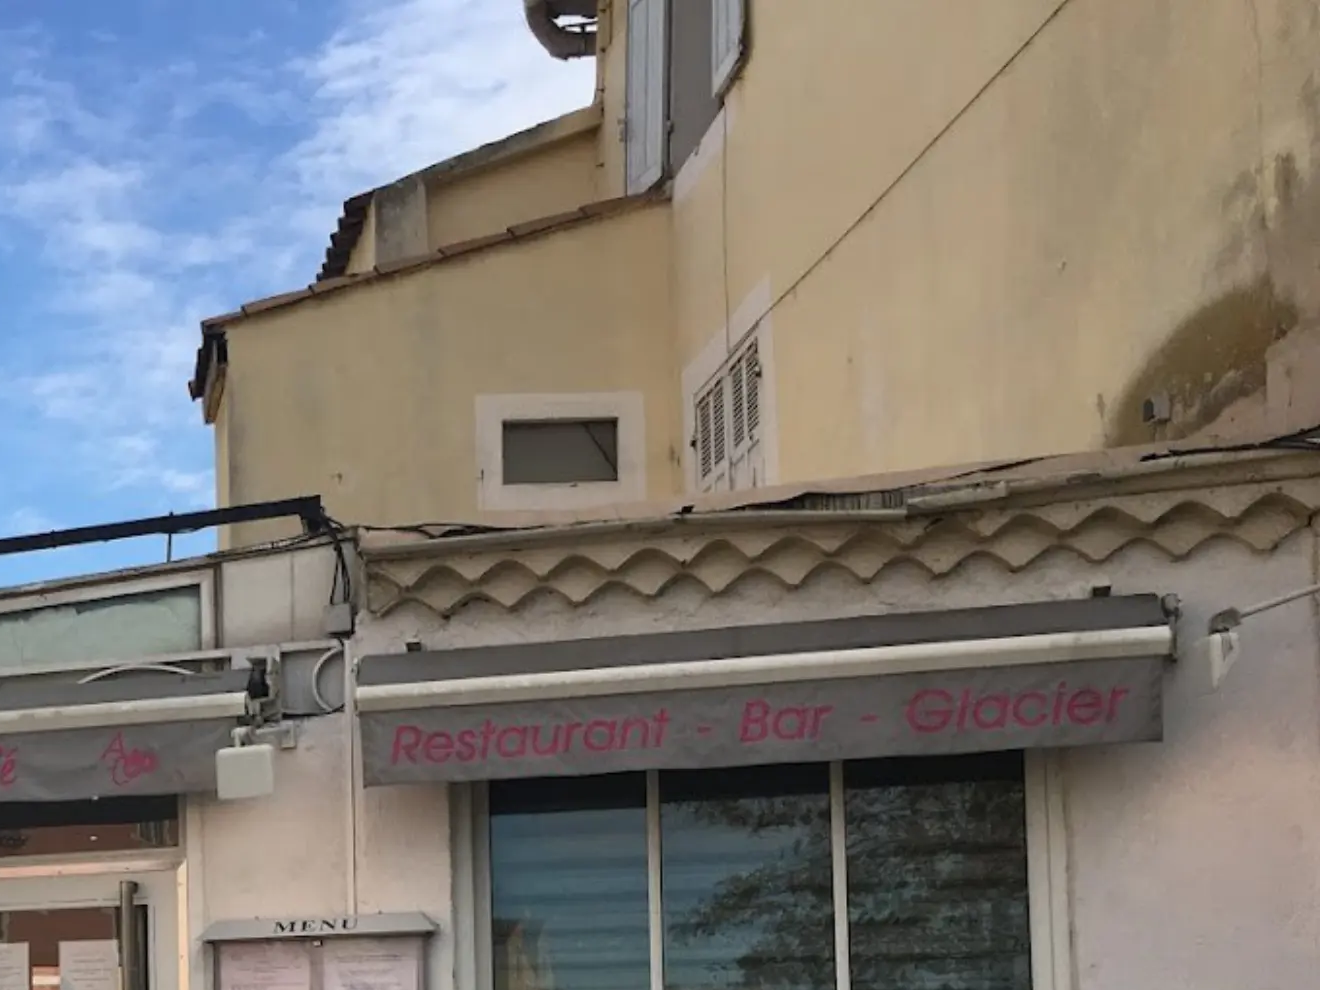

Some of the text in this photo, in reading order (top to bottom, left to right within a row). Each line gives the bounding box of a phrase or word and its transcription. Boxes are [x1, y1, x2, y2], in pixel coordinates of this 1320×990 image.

[390, 706, 671, 767] Restaurant
[739, 698, 834, 744] Bar
[906, 682, 1129, 735] Glacier
[273, 918, 357, 933] MENU
